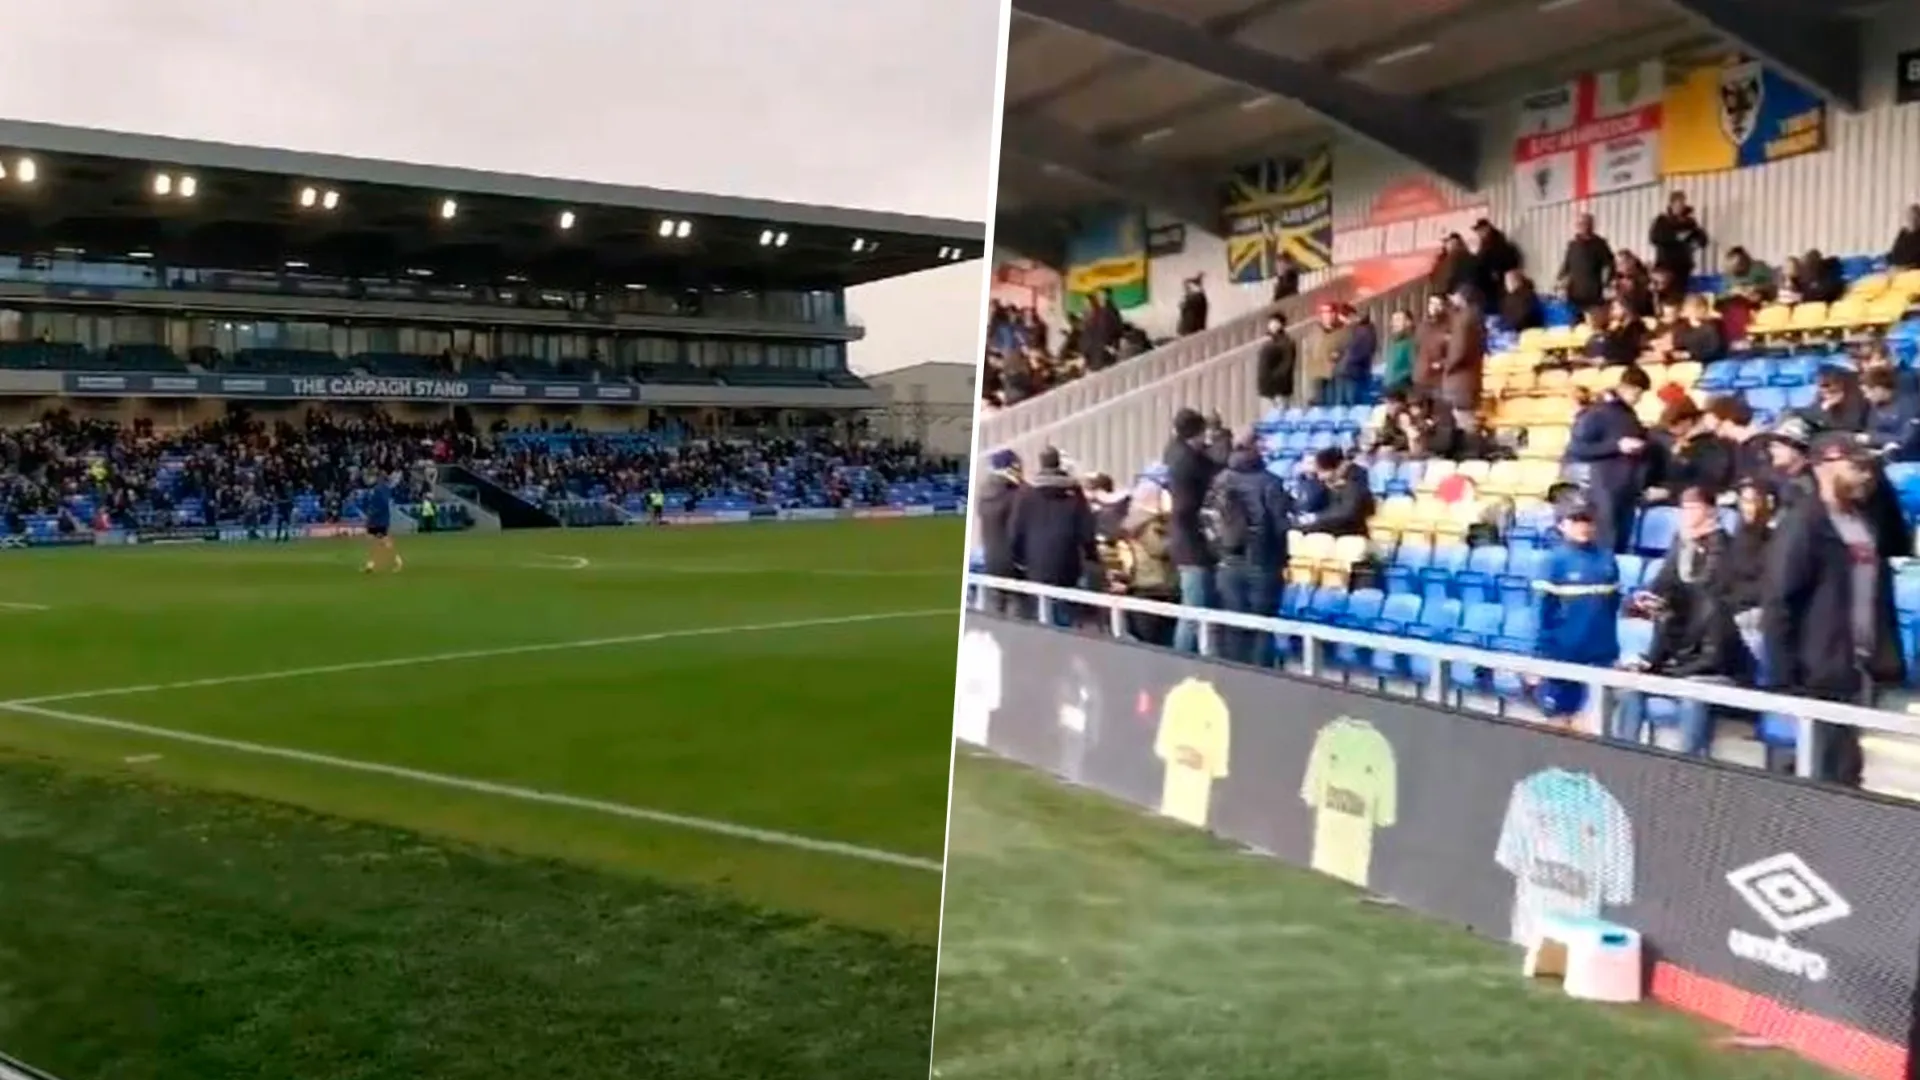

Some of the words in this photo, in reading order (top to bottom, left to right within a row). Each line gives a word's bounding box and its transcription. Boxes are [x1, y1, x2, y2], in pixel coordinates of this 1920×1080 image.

[292, 378, 326, 394] THE
[330, 379, 412, 396] CAPPAGH
[415, 381, 469, 397] STAND
[1727, 928, 1828, 982] umbro
